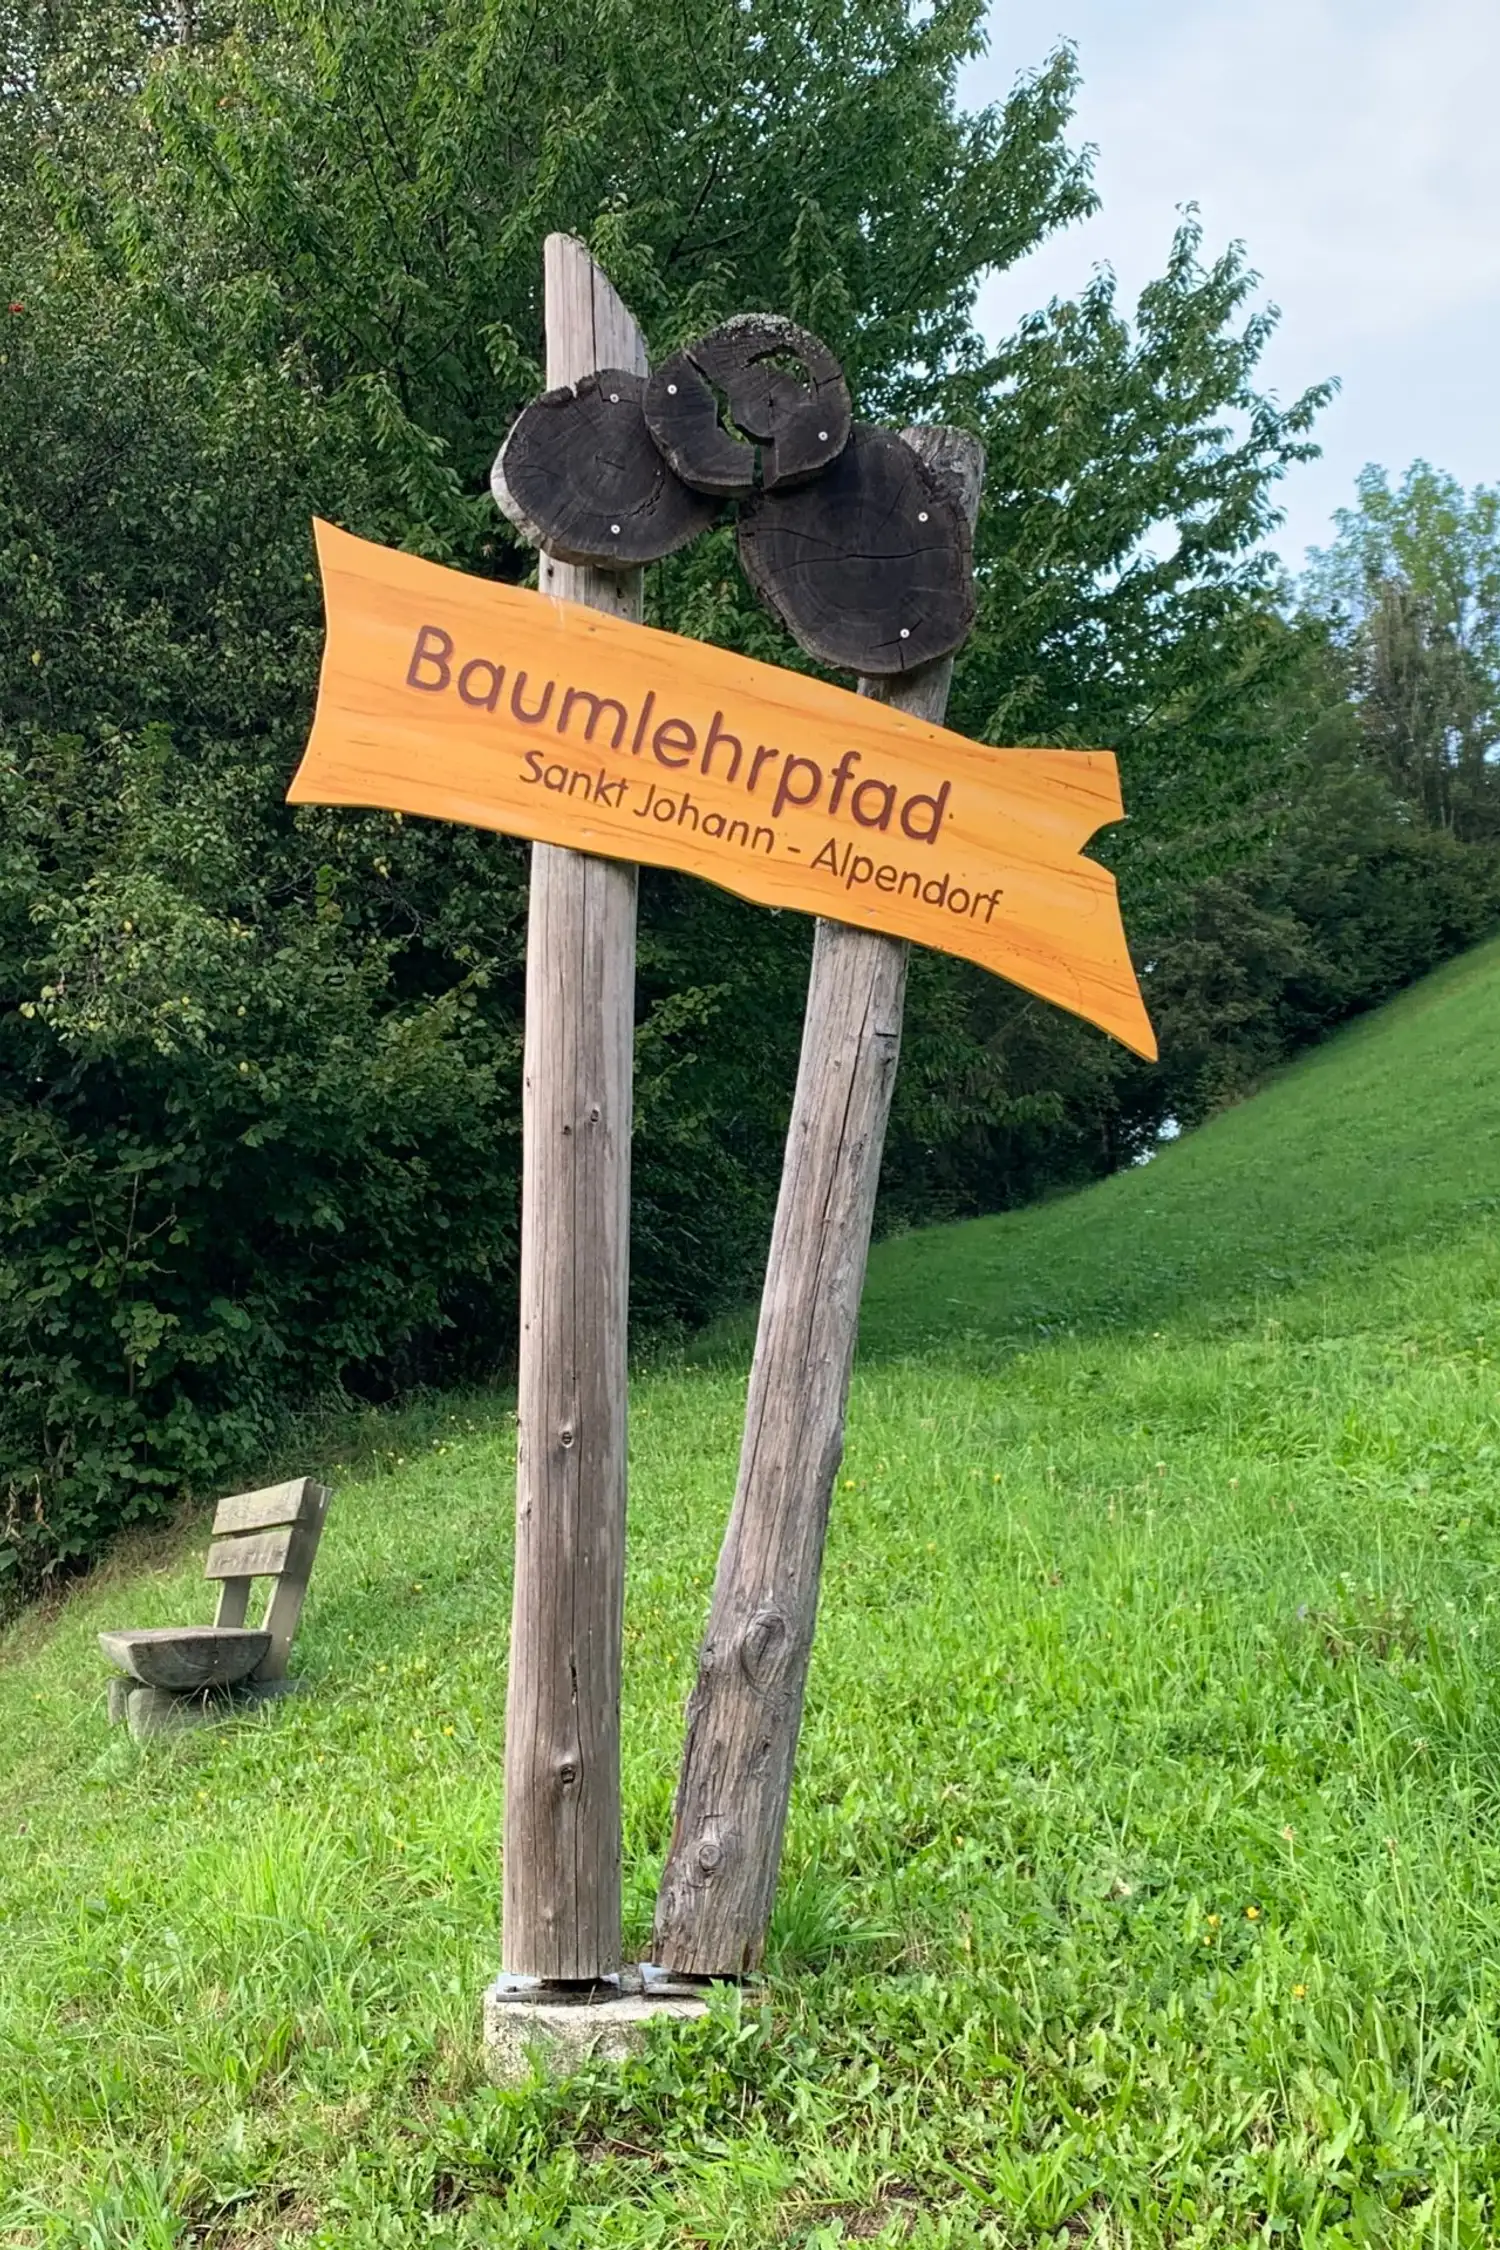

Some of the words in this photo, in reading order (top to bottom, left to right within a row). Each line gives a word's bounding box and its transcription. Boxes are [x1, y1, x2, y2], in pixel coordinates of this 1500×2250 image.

[406, 625, 952, 846] Baumlehrpfad
[520, 750, 628, 808] Sankt
[634, 783, 775, 854] Johann
[810, 838, 1004, 923] Alpendorf
